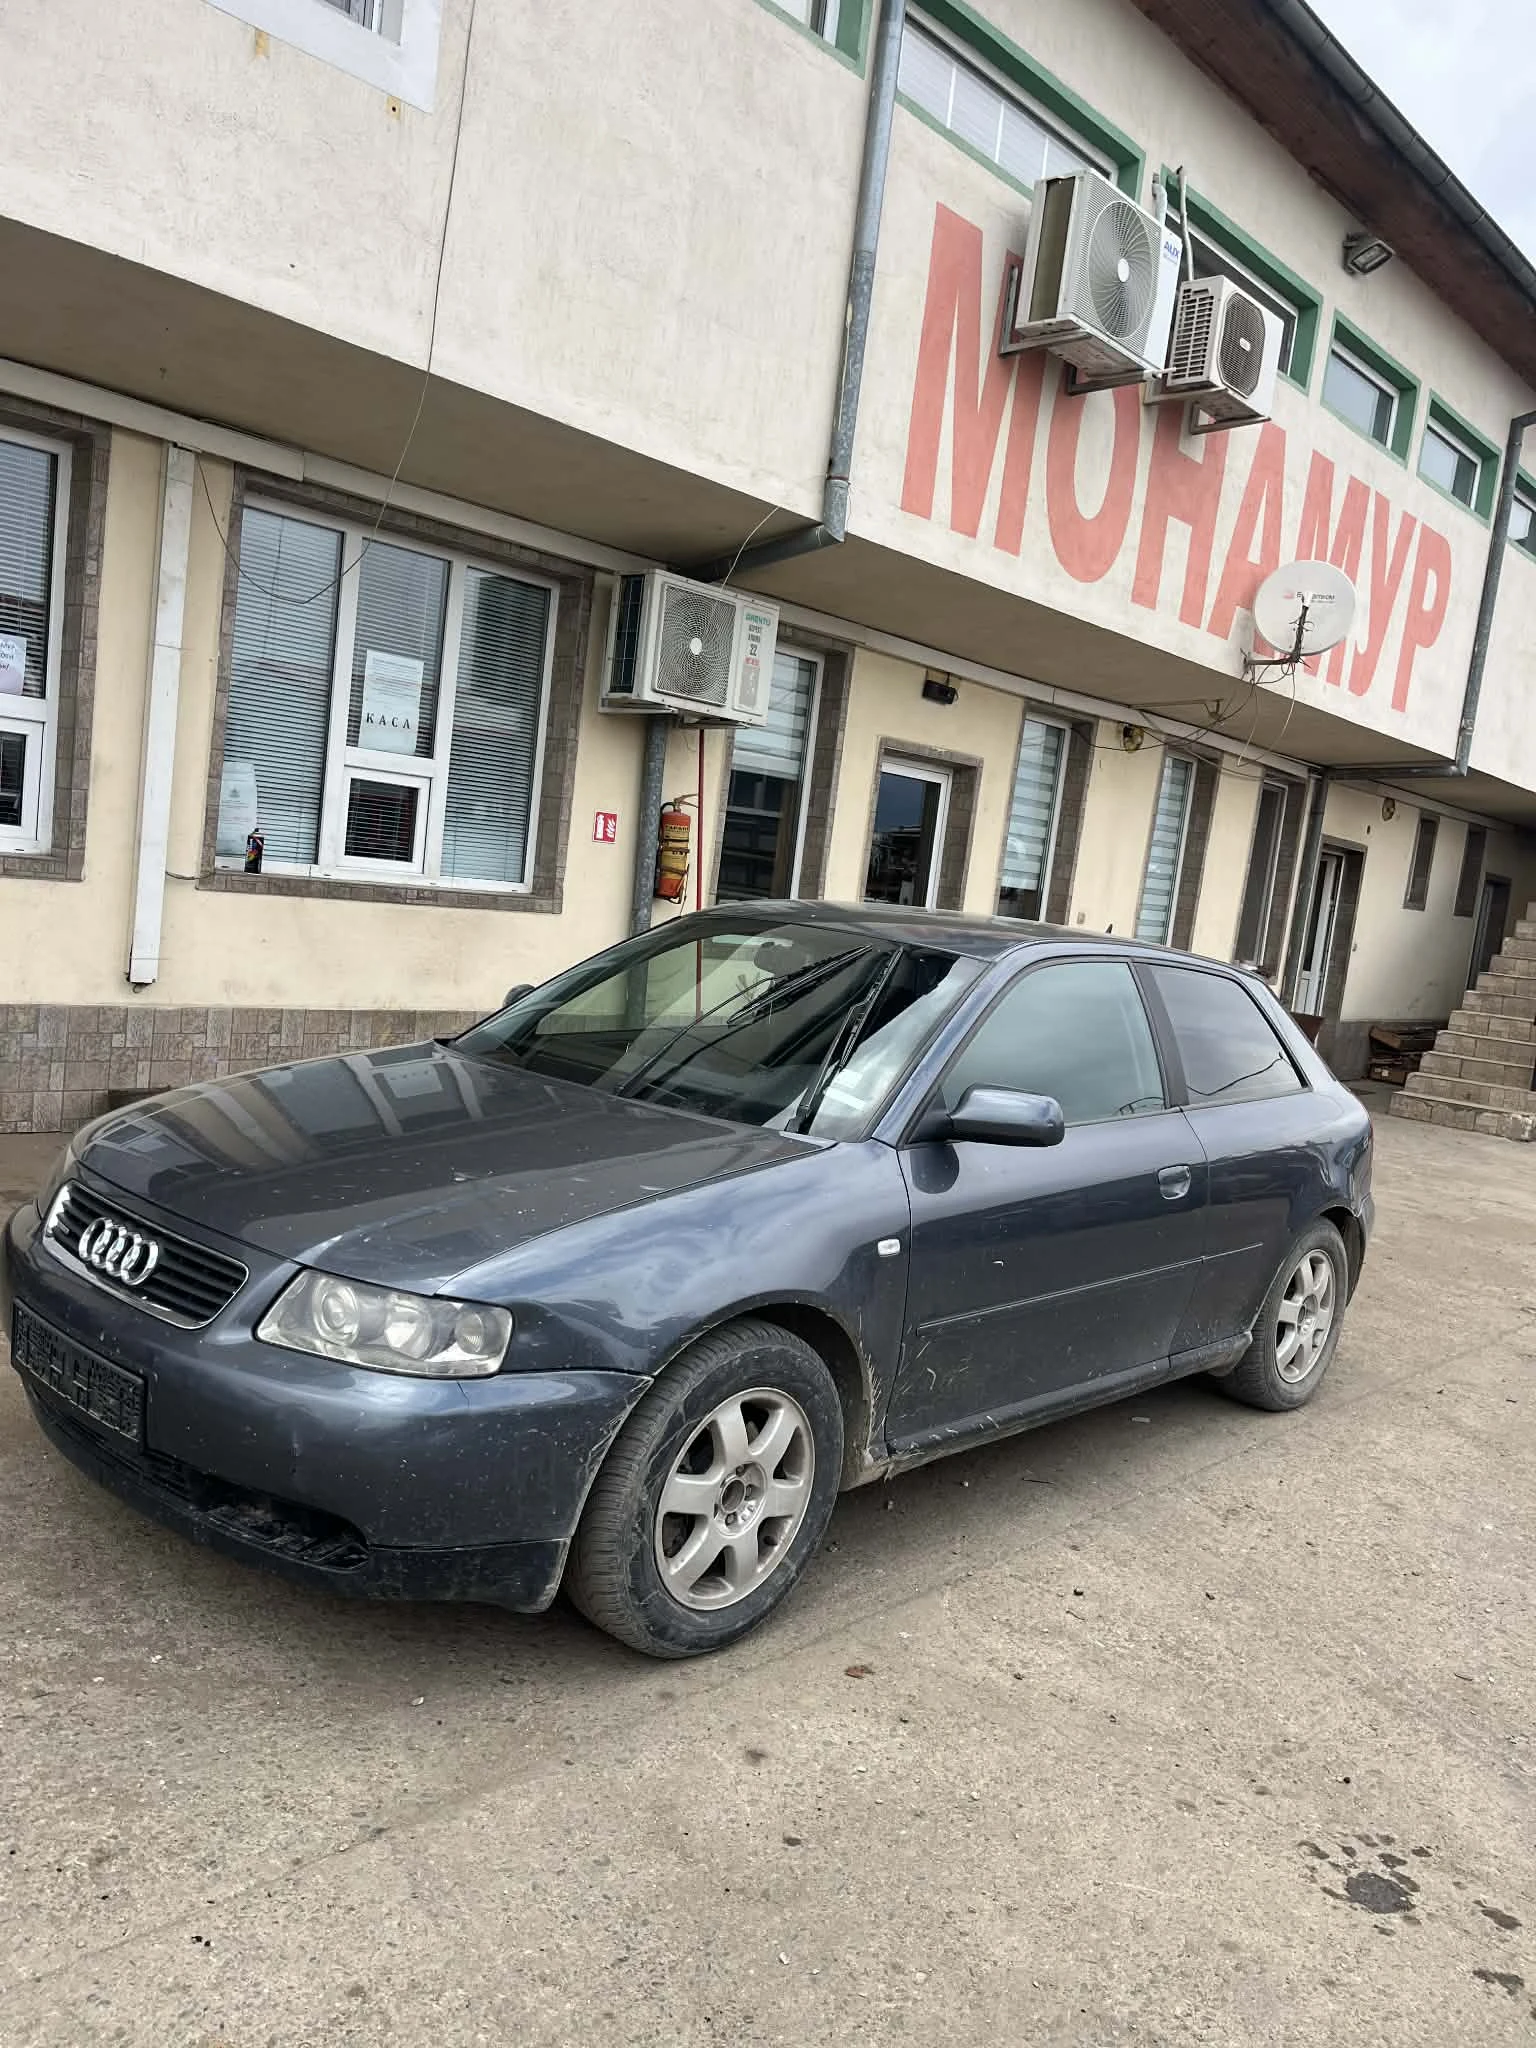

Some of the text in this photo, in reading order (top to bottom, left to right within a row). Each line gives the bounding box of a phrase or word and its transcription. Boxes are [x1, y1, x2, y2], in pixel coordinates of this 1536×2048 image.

[1164, 241, 1180, 258] AUX
[902, 202, 1453, 712] МОНАМУР
[366, 712, 411, 729] КАСА
